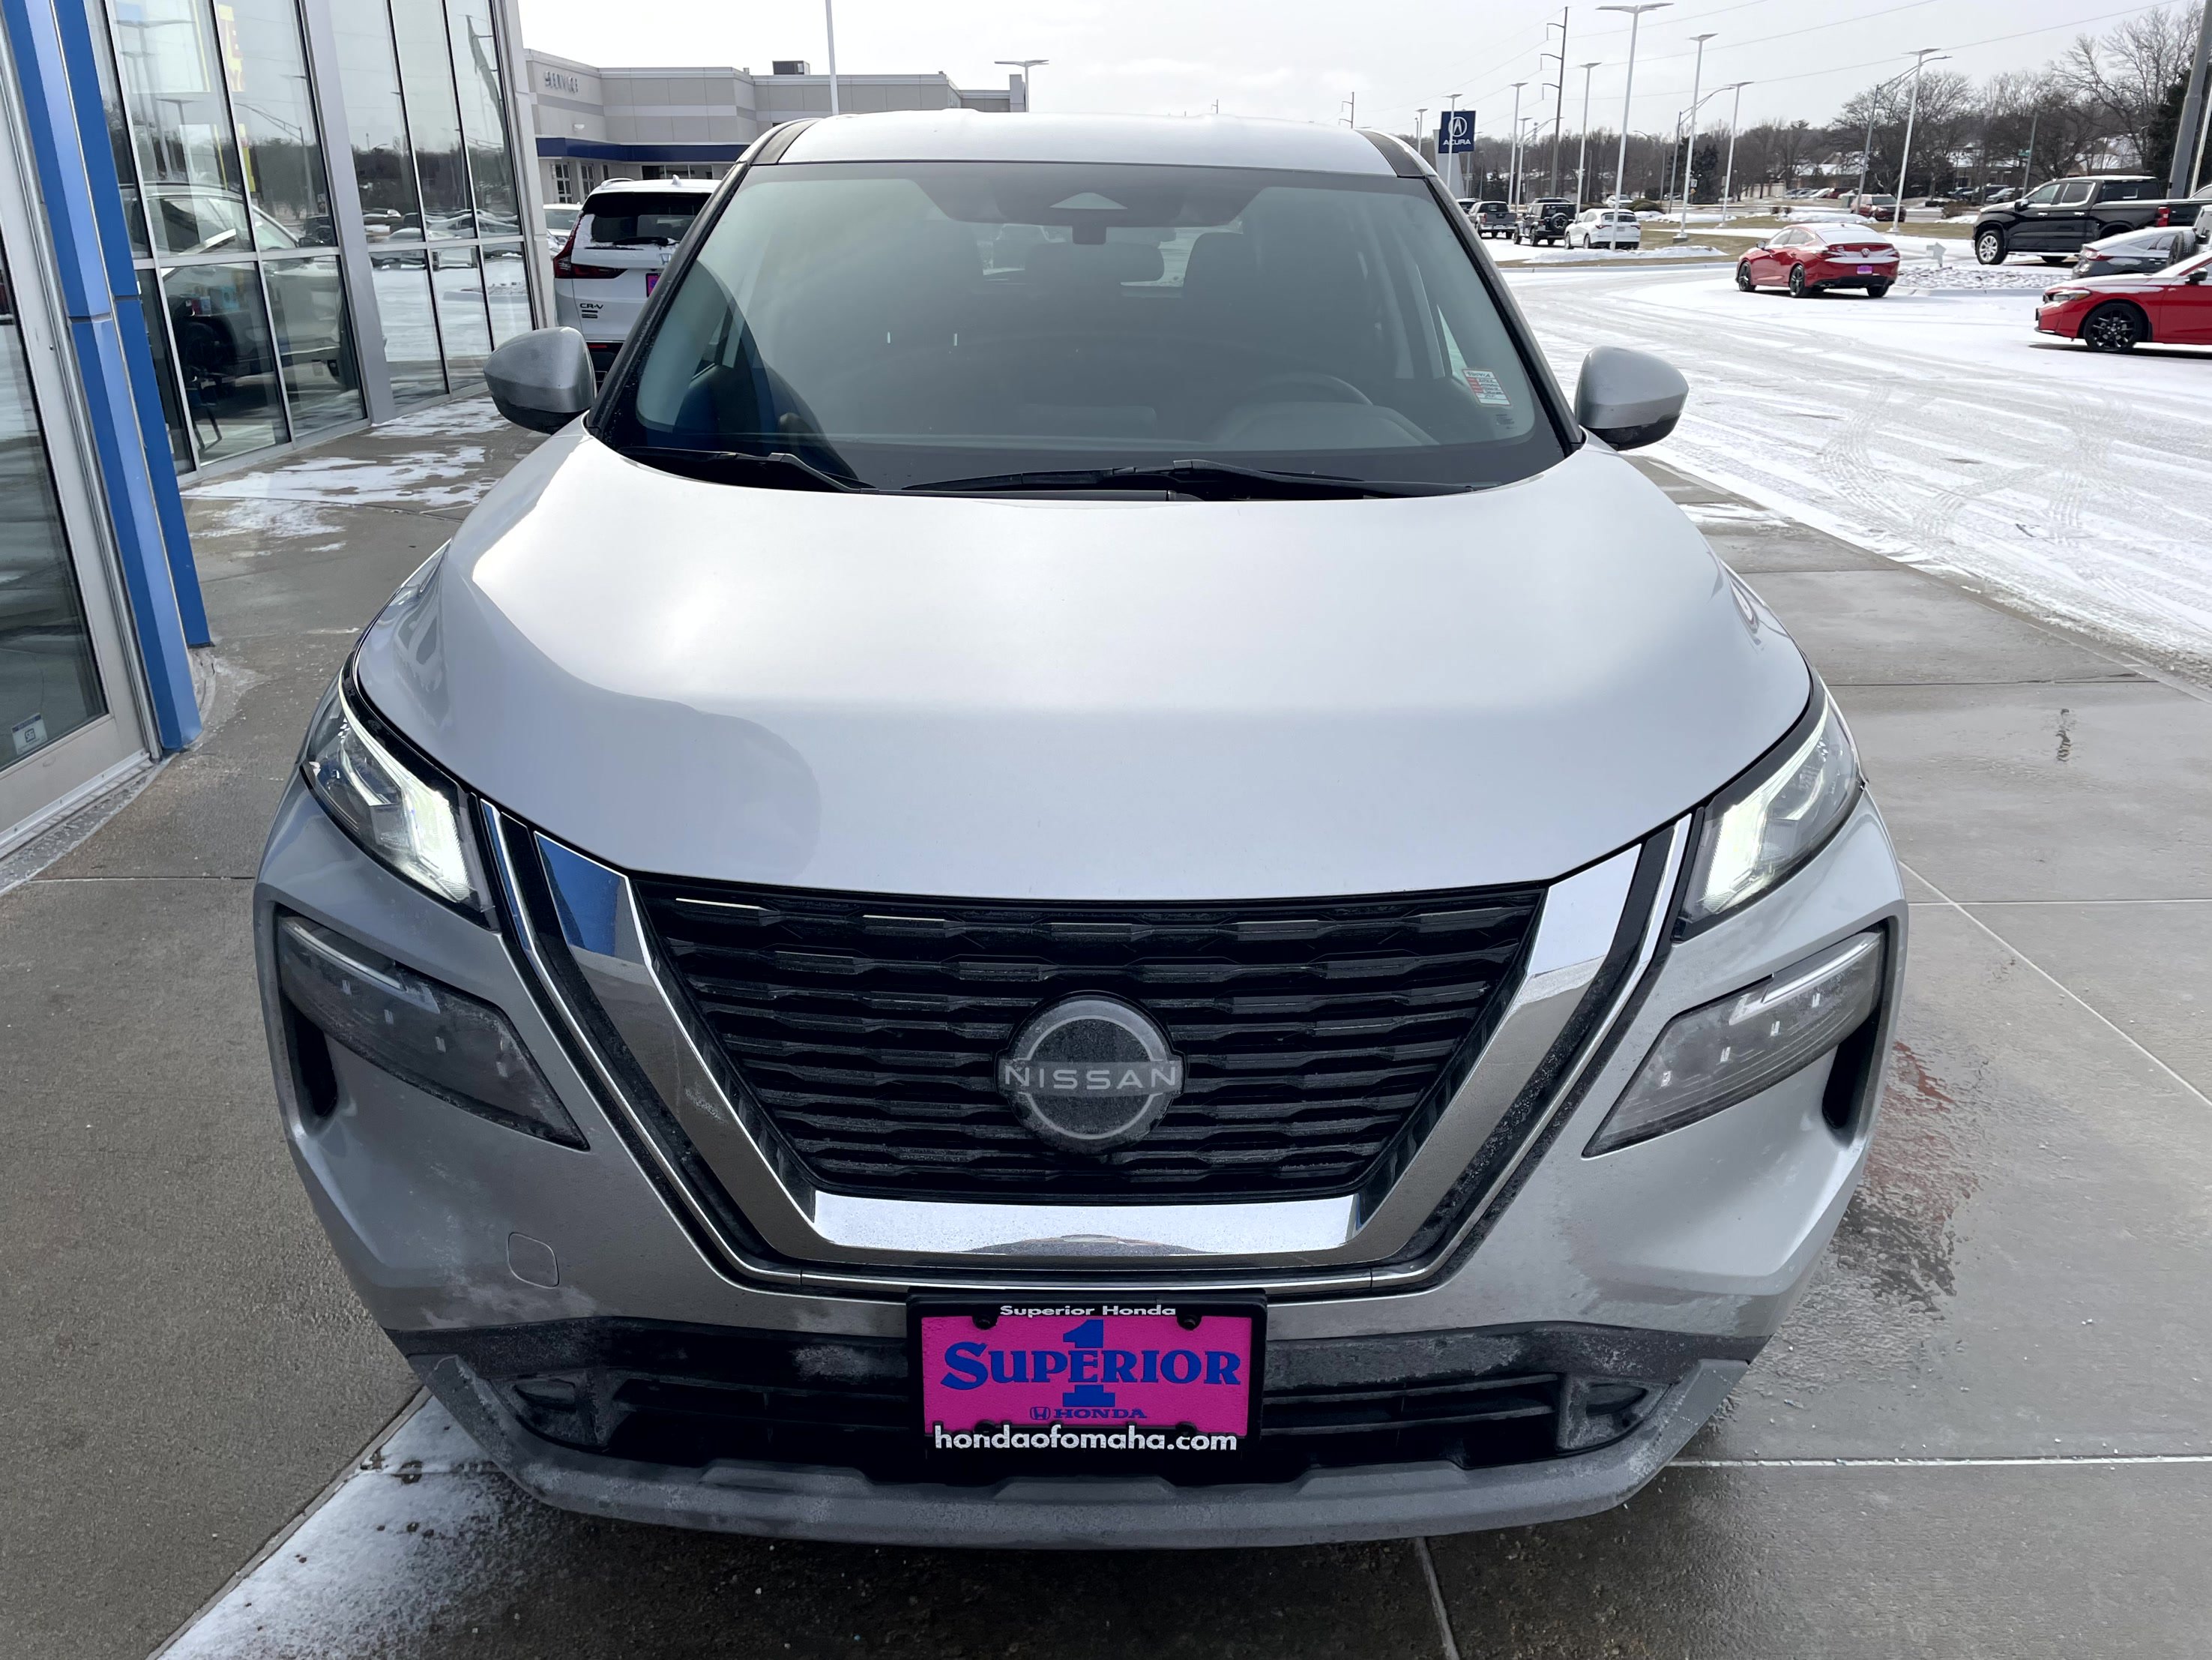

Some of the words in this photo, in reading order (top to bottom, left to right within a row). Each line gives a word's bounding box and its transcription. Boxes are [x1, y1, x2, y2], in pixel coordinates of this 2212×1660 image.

[1004, 1065, 1176, 1089] NISSAN
[999, 1305, 1095, 1318] Superior
[1102, 1305, 1176, 1316] Honda
[940, 1341, 1241, 1390] SUPERIOR
[1053, 1408, 1148, 1419] HONDA
[934, 1423, 1238, 1451] hondaofomaha.com
